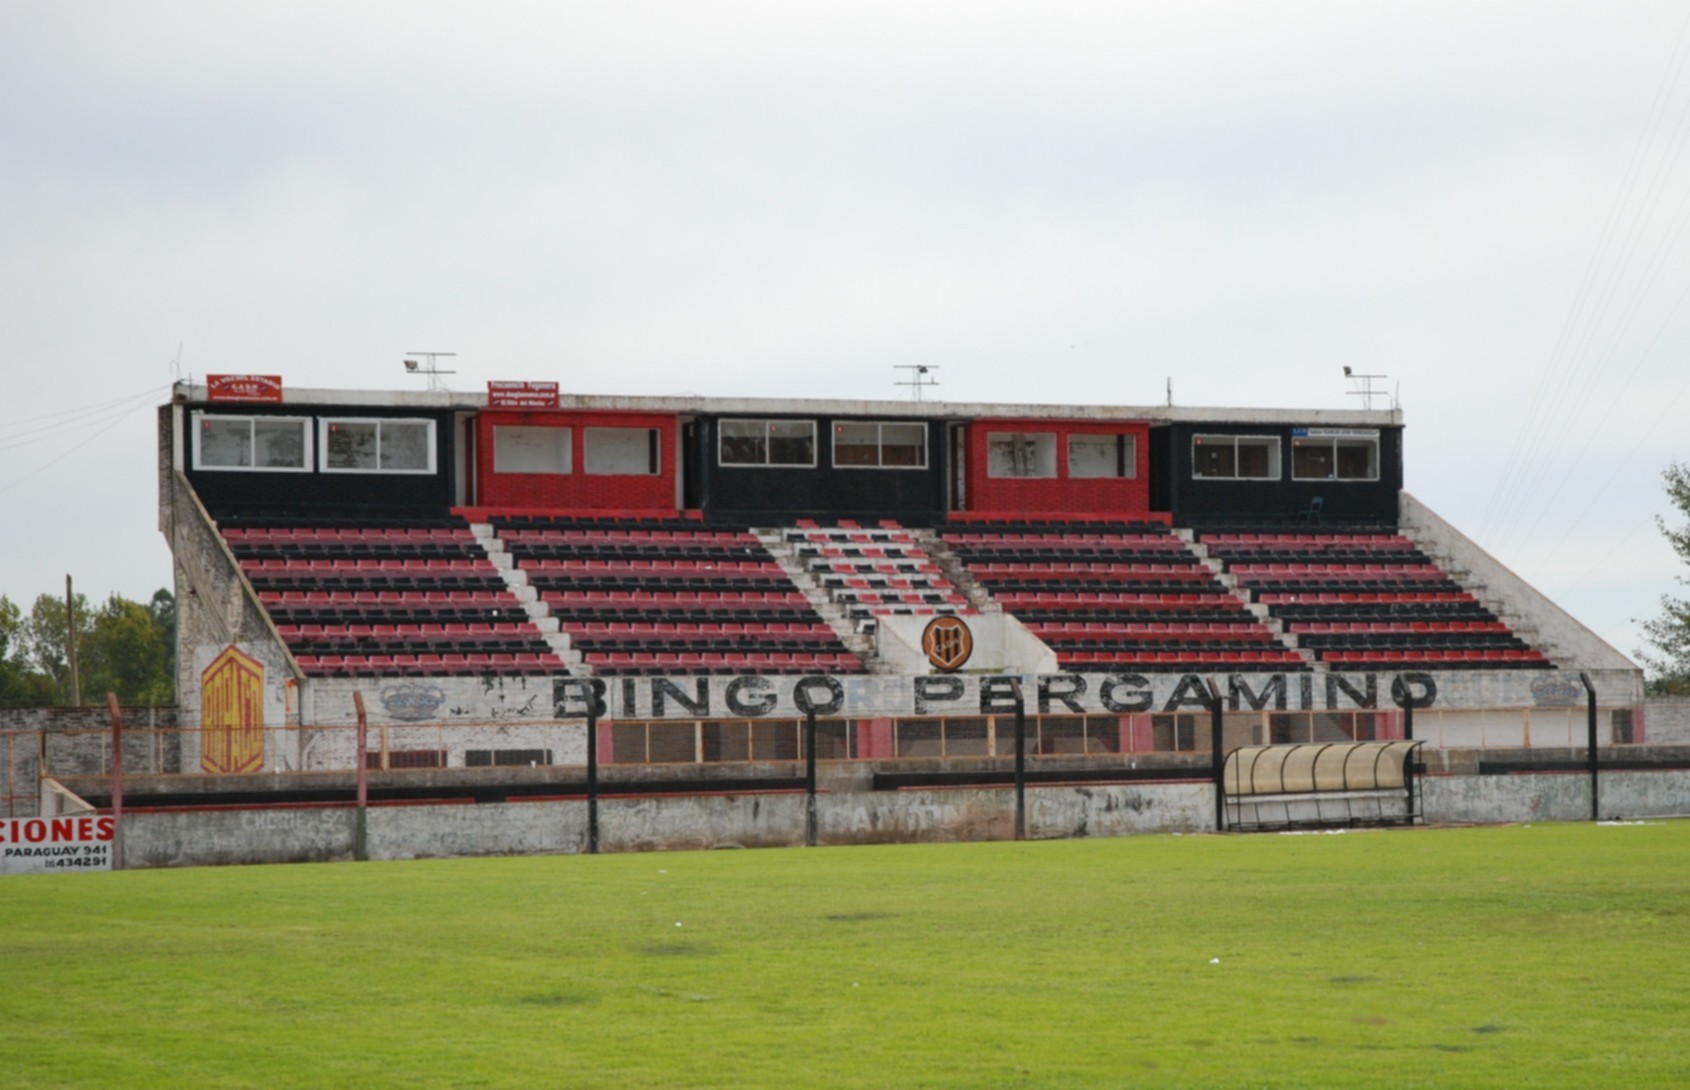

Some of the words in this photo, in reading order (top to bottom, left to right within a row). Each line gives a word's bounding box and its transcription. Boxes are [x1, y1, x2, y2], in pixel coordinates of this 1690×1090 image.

[552, 675, 845, 718] BINGO
[914, 672, 1438, 715] PERGAMINO
[0, 817, 114, 843] IONES
[5, 846, 79, 857] PARAGUAY
[84, 845, 107, 855] 941
[56, 857, 107, 867] 434291
